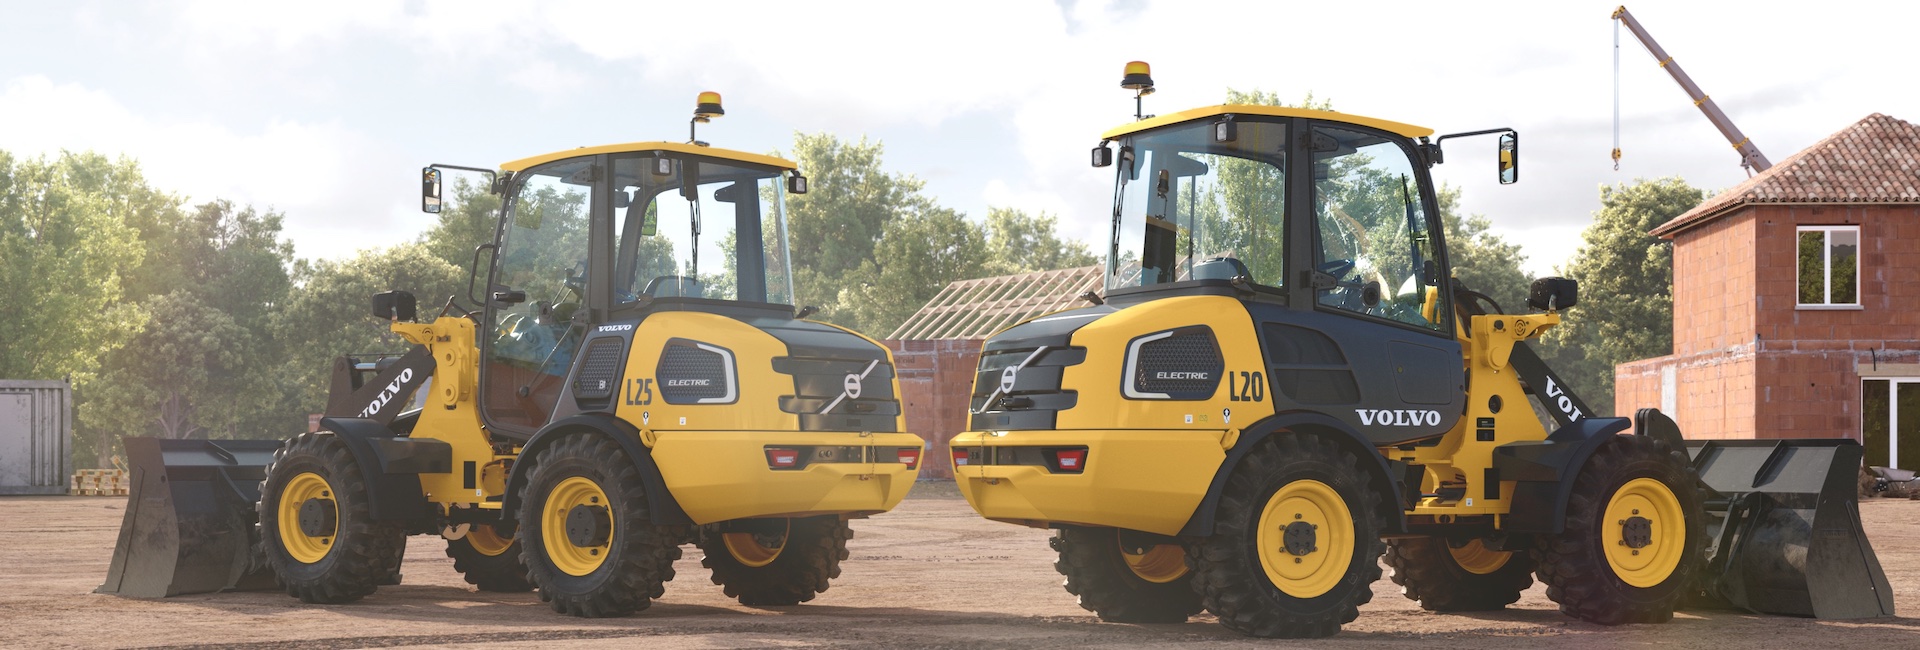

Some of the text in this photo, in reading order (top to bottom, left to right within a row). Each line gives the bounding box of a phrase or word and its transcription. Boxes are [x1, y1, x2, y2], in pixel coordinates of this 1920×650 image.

[598, 324, 633, 332] VOLVO
[1156, 371, 1208, 380] ELECTRIC
[1229, 370, 1264, 402] L20
[626, 378, 653, 406] L25
[1546, 375, 1586, 423] VOL
[1355, 409, 1442, 426] VOLVO
